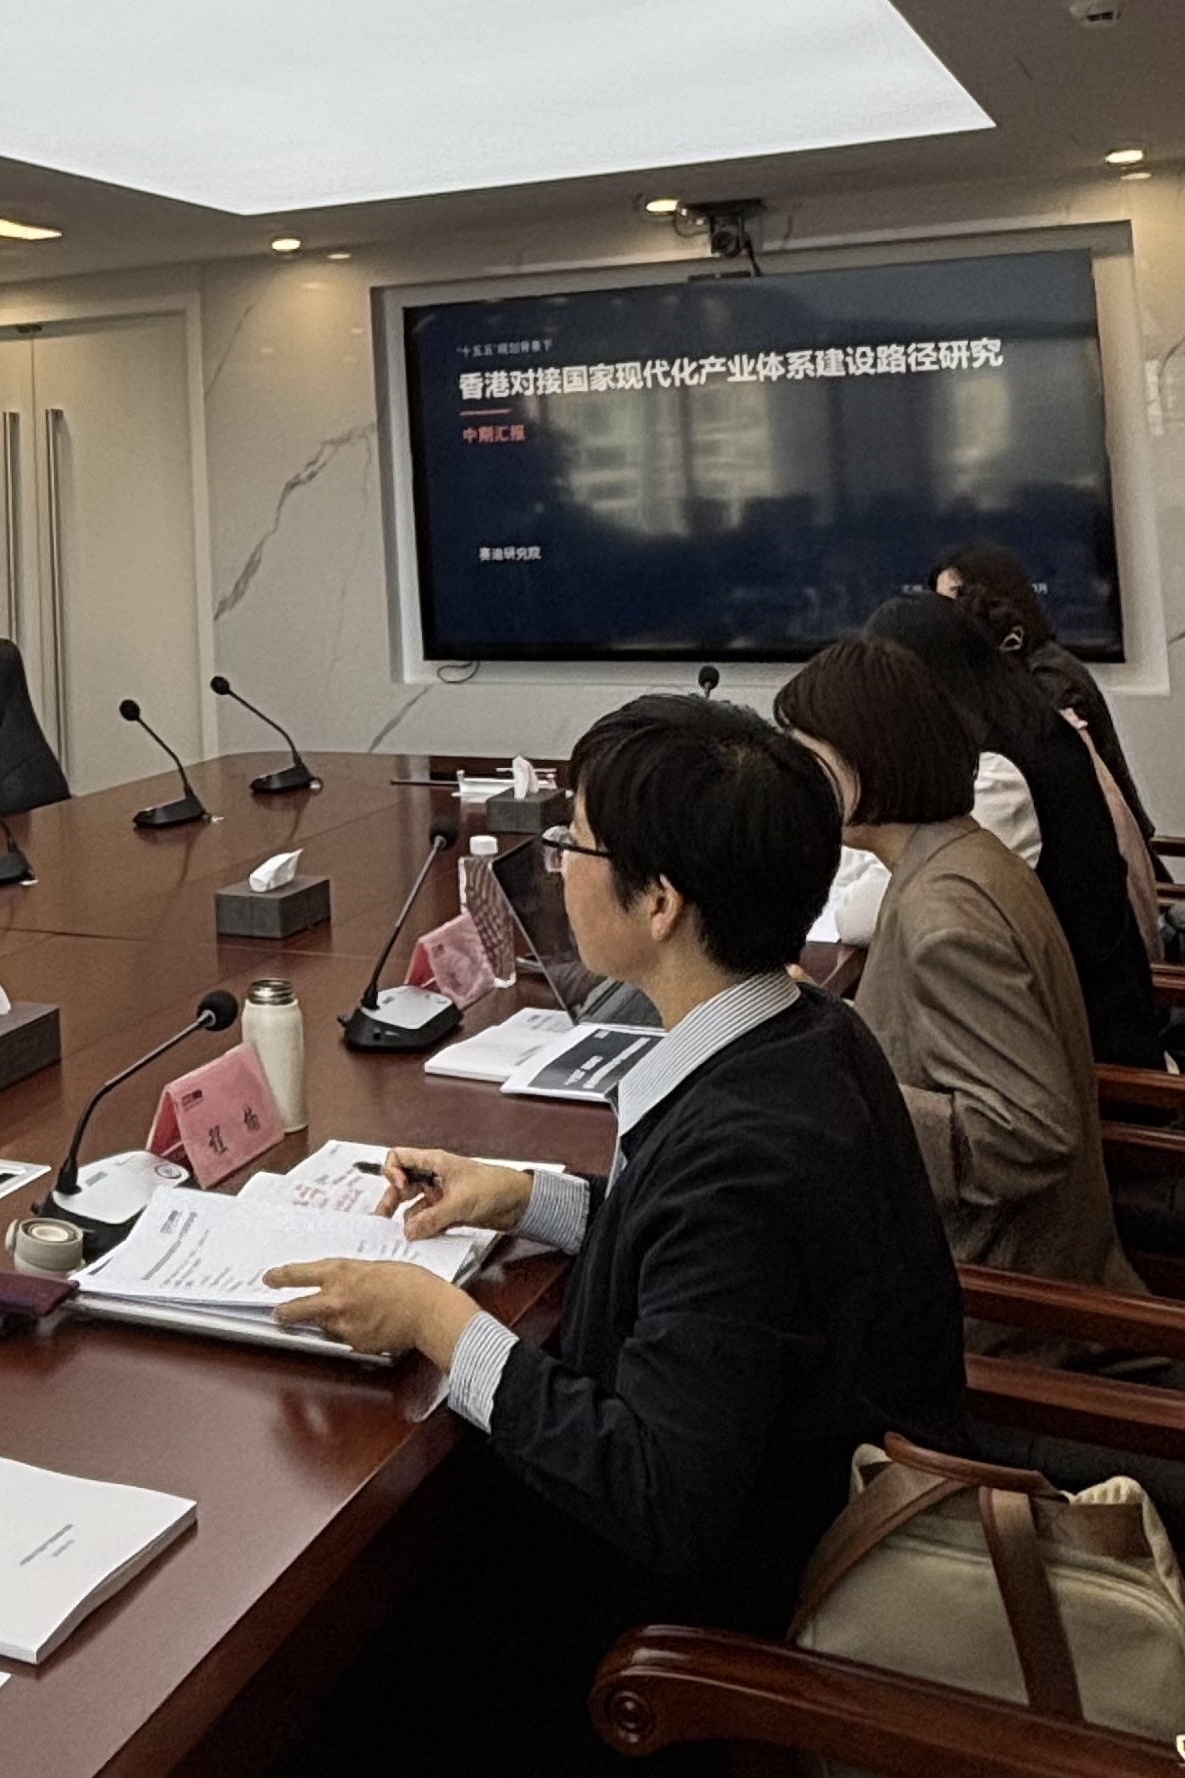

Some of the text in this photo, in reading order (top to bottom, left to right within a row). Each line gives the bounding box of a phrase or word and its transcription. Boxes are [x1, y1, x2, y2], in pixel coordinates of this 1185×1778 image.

[459, 337, 1004, 400] 香港对接国家现代化产业体系建设路径研究
[463, 424, 526, 443] 中期汇报
